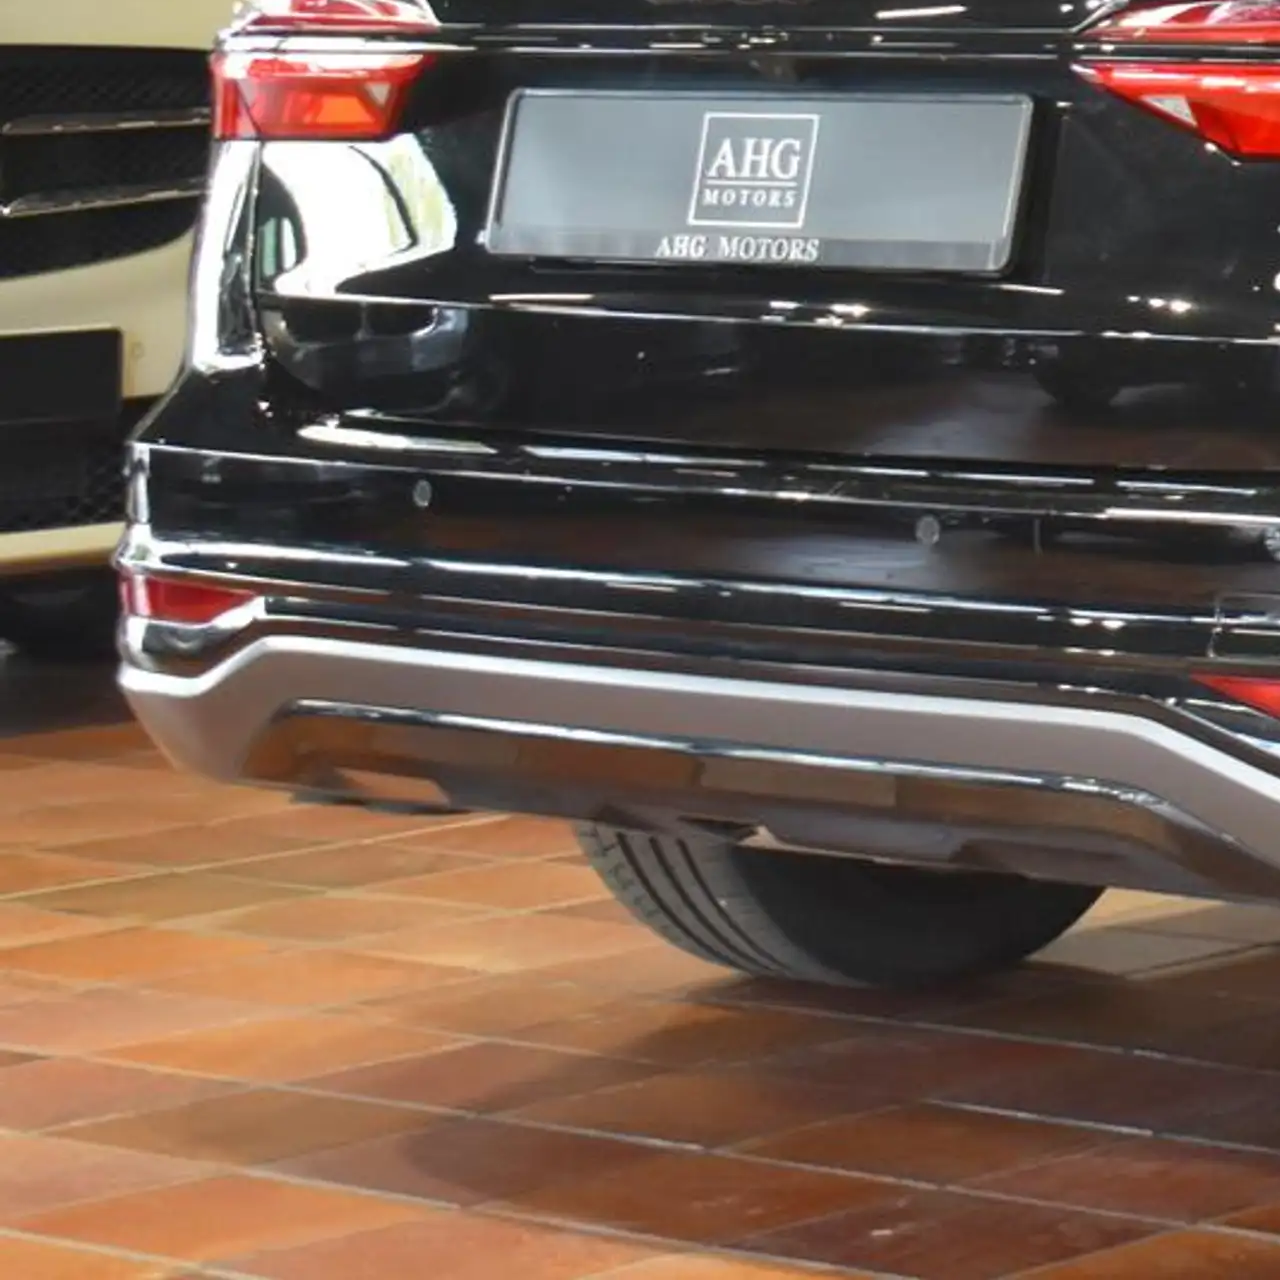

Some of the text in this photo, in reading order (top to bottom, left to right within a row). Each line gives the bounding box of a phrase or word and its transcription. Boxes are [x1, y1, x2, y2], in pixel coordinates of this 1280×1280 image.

[705, 136, 802, 180] AHG
[702, 188, 797, 208] MOTORS
[655, 233, 820, 262] AHG MOTORS
